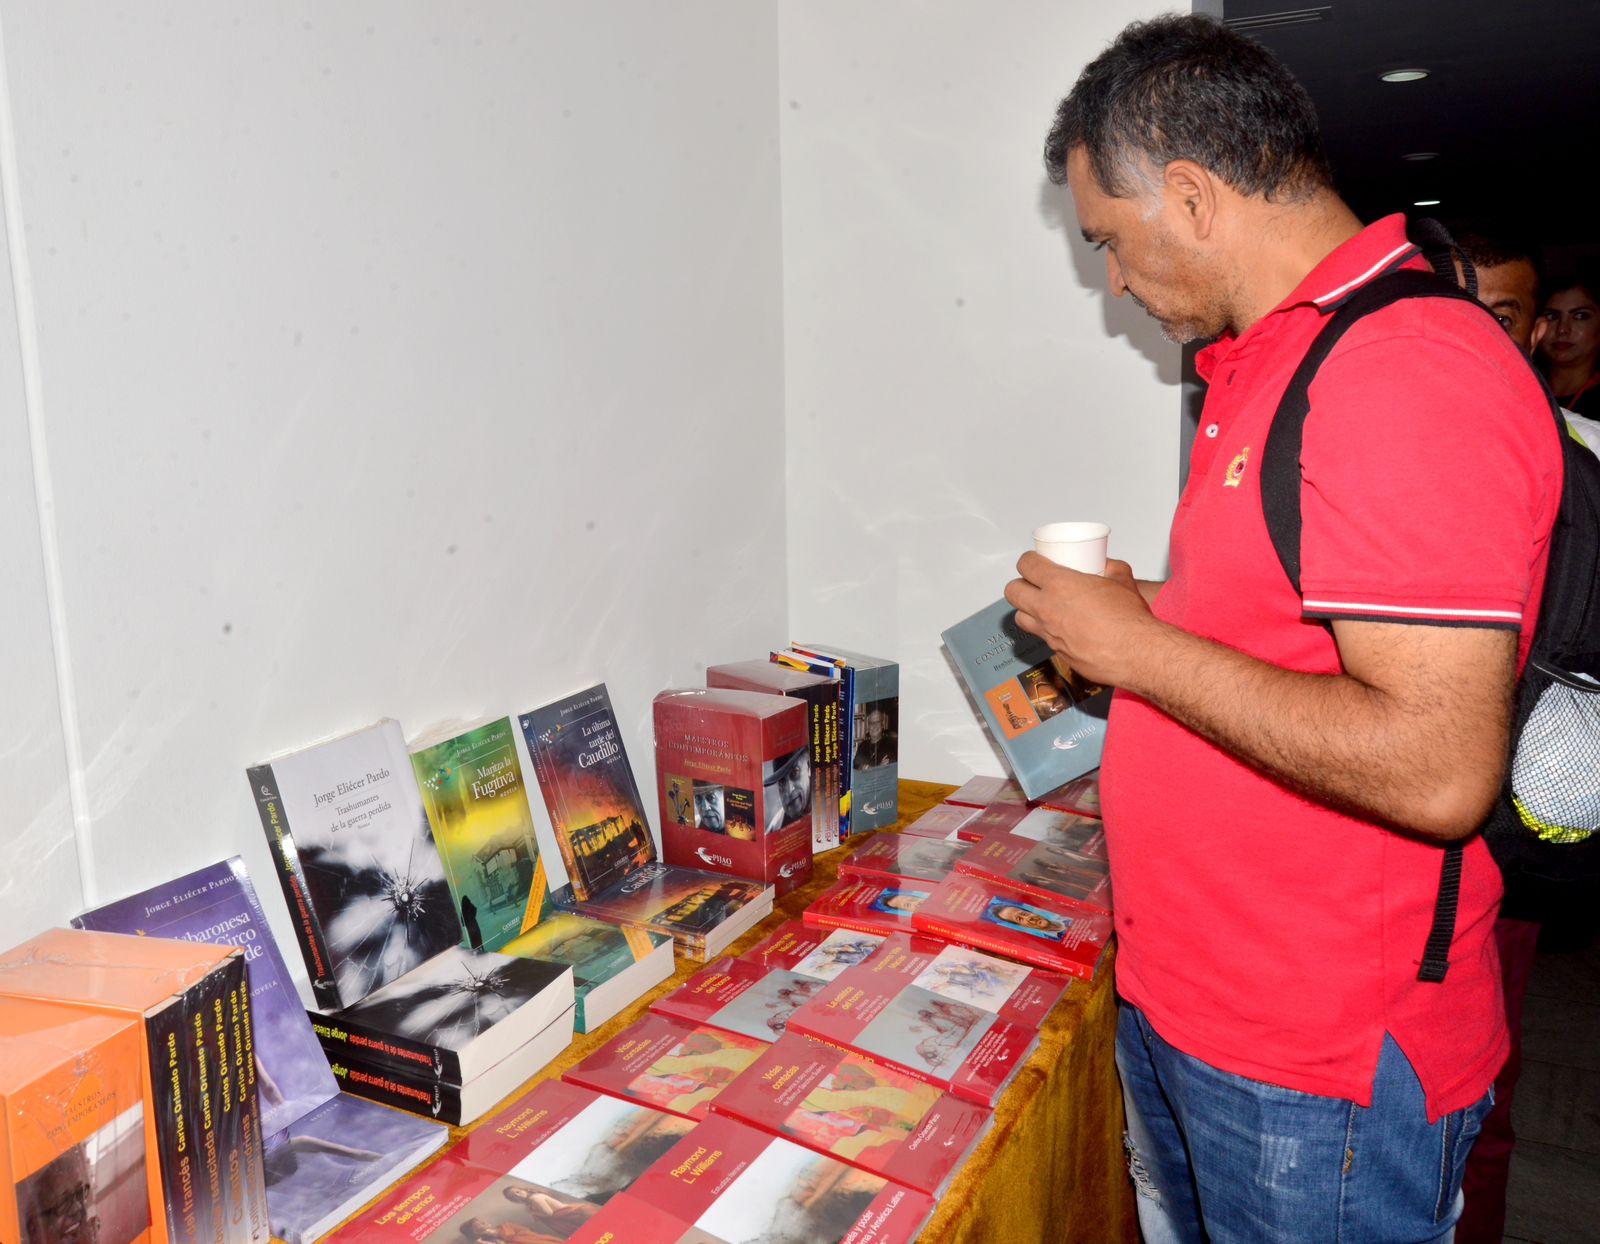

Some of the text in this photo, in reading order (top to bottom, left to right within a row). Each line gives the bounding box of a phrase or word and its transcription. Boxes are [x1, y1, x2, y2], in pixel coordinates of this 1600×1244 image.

[581, 719, 611, 737] La última
[589, 729, 615, 749] tarde del
[504, 756, 512, 766] la
[578, 740, 619, 769] Caudillo
[313, 768, 390, 808] Jorge Eliécer Pardo
[472, 771, 515, 799] Fugitiva
[268, 802, 278, 825] Pardo
[330, 801, 392, 832] de la guerra perdida
[335, 794, 380, 816] Trashumantes
[712, 854, 732, 865] PIJAO
[145, 875, 235, 918] JORGE ELIÉCER PARDO
[230, 990, 238, 1023] Pardo
[240, 980, 248, 1011] Pardo
[214, 998, 223, 1032] Pardo
[194, 1013, 204, 1047] Pardo
[243, 1011, 251, 1051] Orlando
[331, 1027, 348, 1042] Jorge
[168, 1032, 177, 1068] Pardo
[218, 1032, 227, 1076] Orlando
[233, 1023, 242, 1066] Orlando
[368, 1040, 384, 1050] guerra
[390, 1045, 397, 1055] de
[397, 1047, 433, 1066] Trashumantes
[614, 1040, 636, 1052] Vidas
[623, 1039, 652, 1061] contadas
[198, 1047, 208, 1092] Orlando
[331, 1063, 348, 1079] Jorge
[368, 1076, 384, 1088] guerra
[762, 1064, 783, 1080] Vidas
[772, 1064, 799, 1090] contadas
[171, 1068, 182, 1114] Orlando
[384, 1080, 389, 1091] la
[389, 1082, 397, 1092] de
[397, 1084, 432, 1105] Trashumantes
[203, 1093, 212, 1130] Carlos
[496, 1107, 534, 1135] Raymond
[514, 1109, 549, 1132] Williams
[176, 1114, 186, 1153] Carlos
[670, 1145, 707, 1178] Raymond
[690, 1149, 723, 1177] Williams
[179, 1156, 193, 1213] francés
[374, 1185, 431, 1225] Los tiempos
[396, 1193, 436, 1225] del amor
[870, 1211, 892, 1232] América
[887, 1190, 906, 1215] Latina
[857, 1208, 875, 1231] poder
